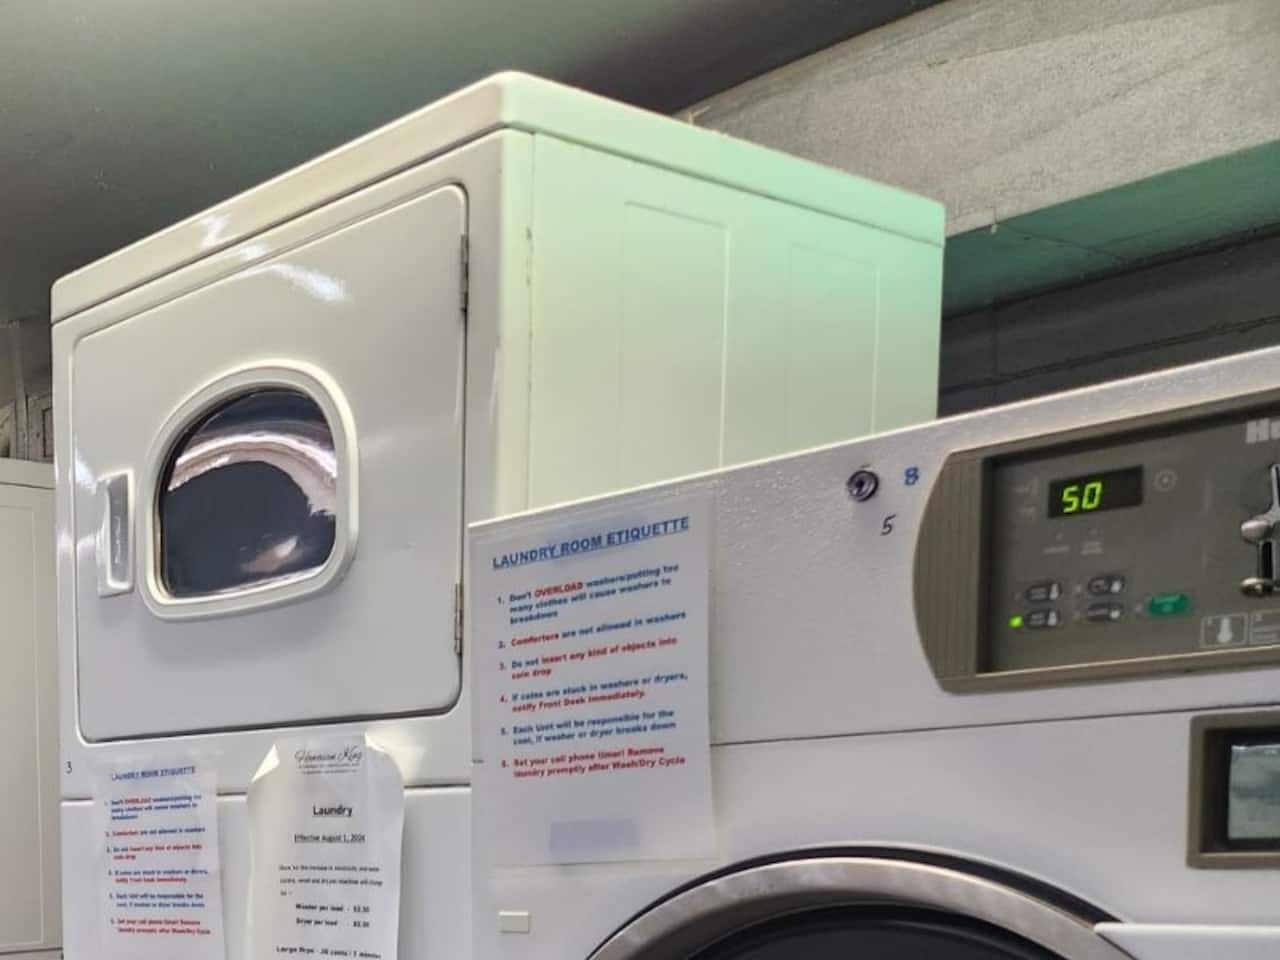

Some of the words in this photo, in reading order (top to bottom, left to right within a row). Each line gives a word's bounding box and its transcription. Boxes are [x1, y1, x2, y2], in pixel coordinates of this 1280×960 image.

[905, 466, 919, 486] 8
[1062, 481, 1103, 513] 50
[881, 513, 897, 535] 5
[492, 545, 557, 570] LAUNDRY
[560, 534, 603, 557] ROOM
[607, 516, 690, 546] ETIQUETTE
[534, 581, 584, 598] OVERLOAD
[646, 611, 687, 625] washers
[312, 804, 353, 818] Laundry
